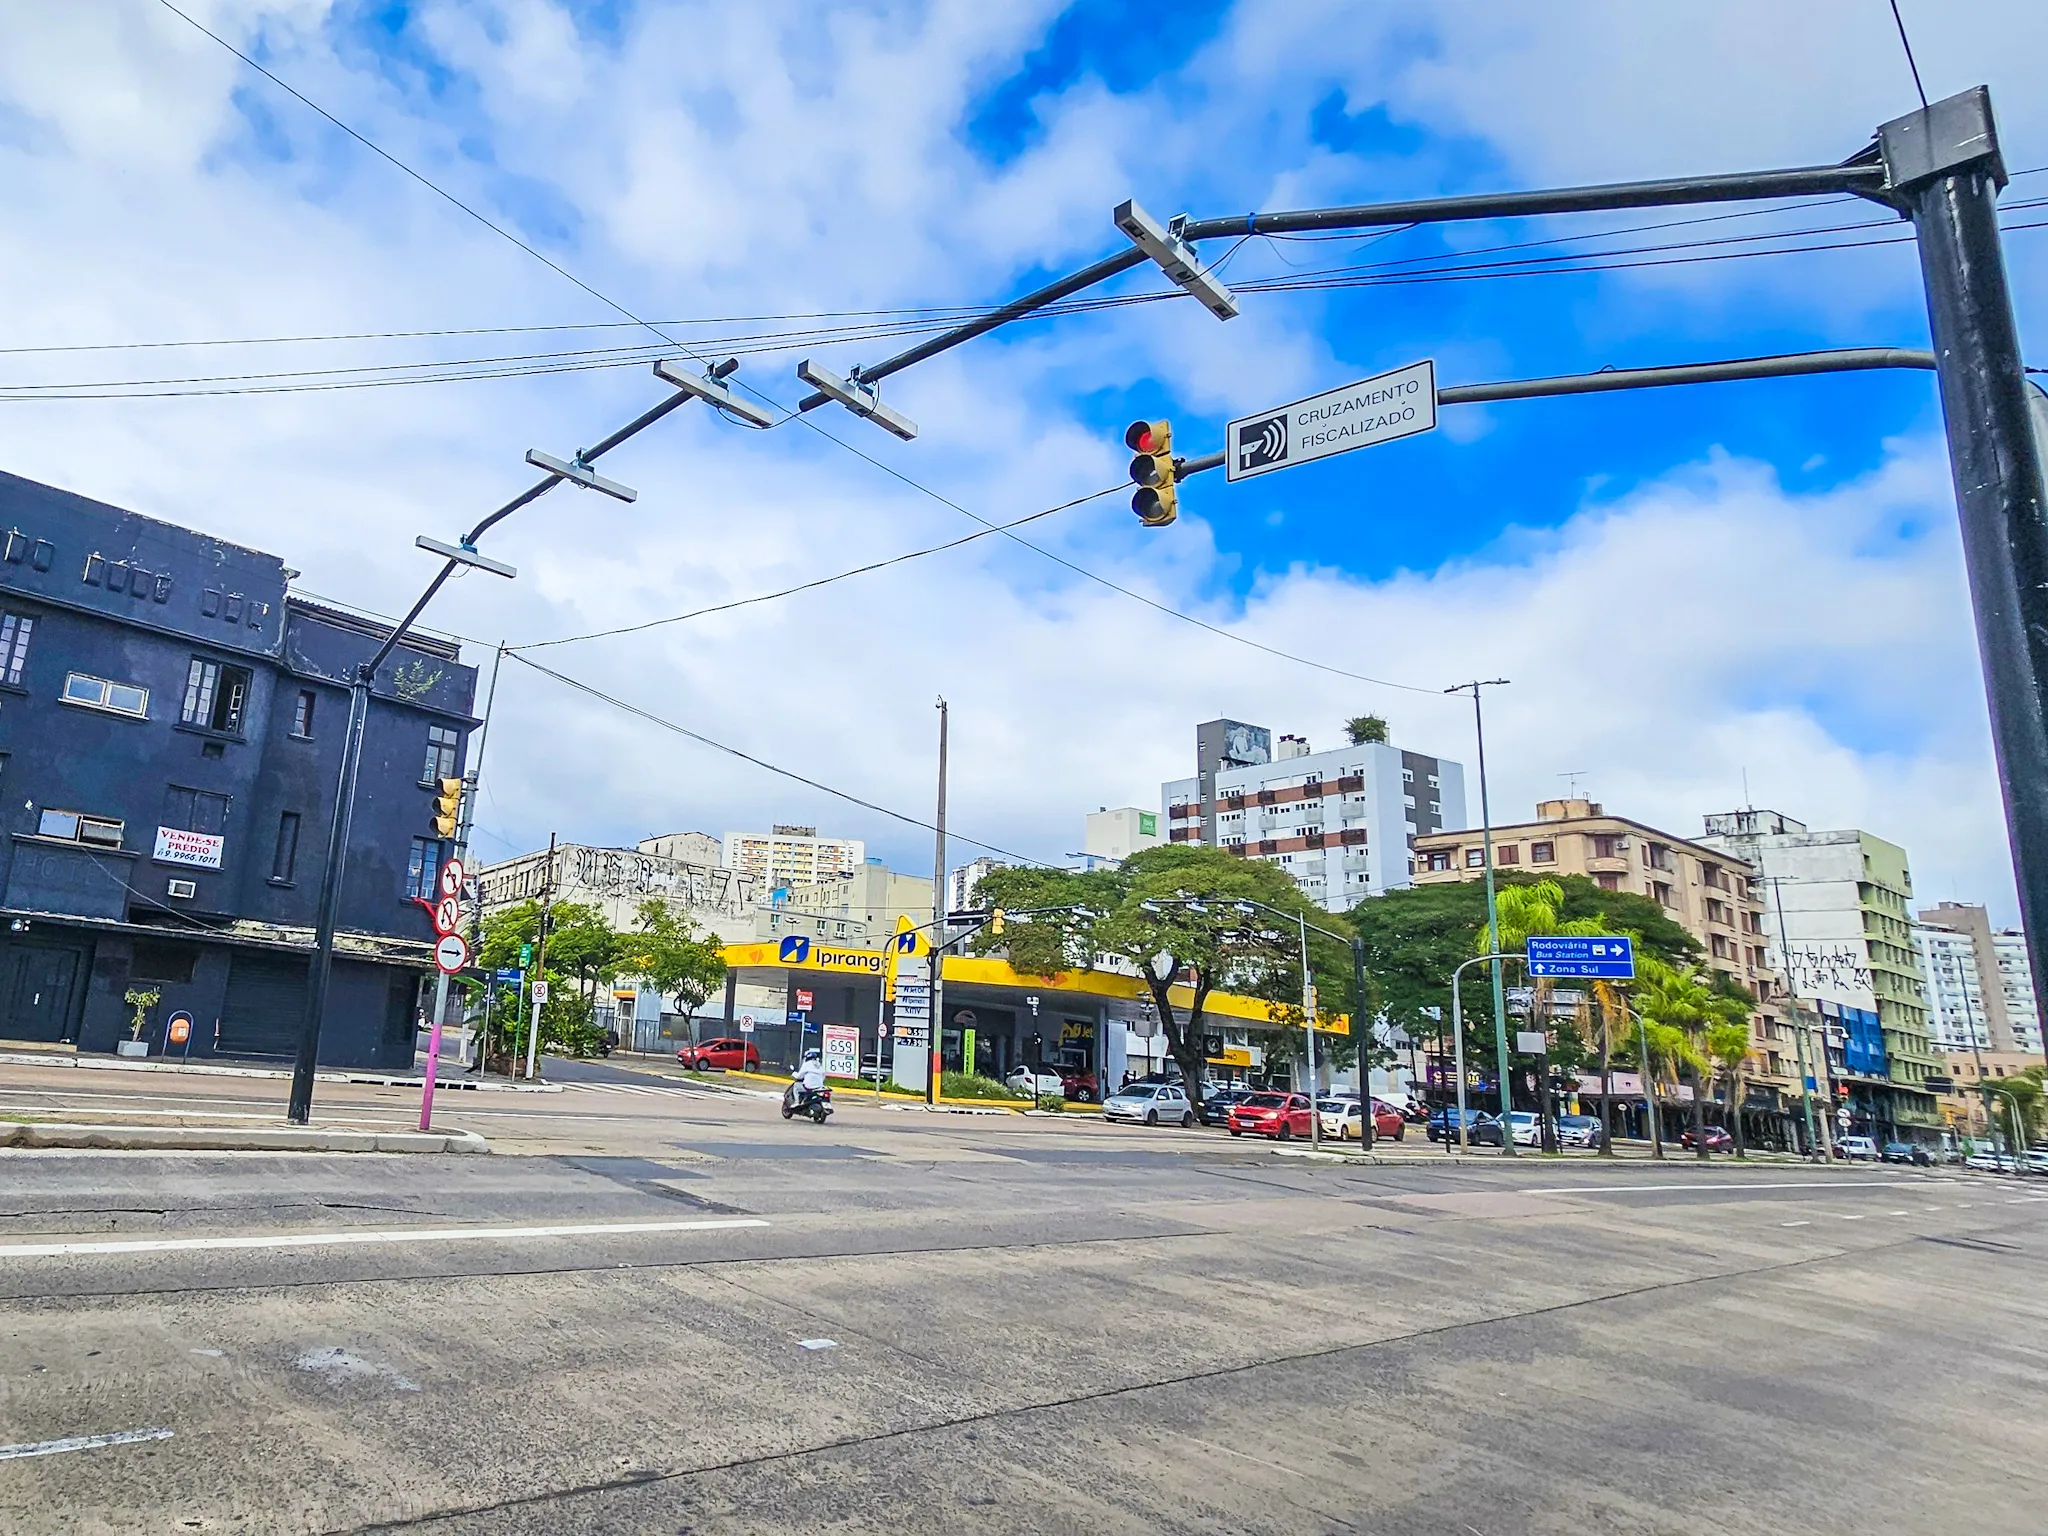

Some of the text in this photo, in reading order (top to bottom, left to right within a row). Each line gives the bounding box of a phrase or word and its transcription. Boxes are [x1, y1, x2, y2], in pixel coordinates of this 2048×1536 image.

[1298, 380, 1419, 426] CRUZAMENTO
[1302, 407, 1415, 449] FISCALIZADO
[161, 830, 220, 848] VENDE-SE
[168, 841, 210, 855] PRÉDIO
[1531, 941, 1588, 950] Rodoviária
[1536, 951, 1589, 959] Bus Station
[1549, 964, 1599, 974] Zona Sul
